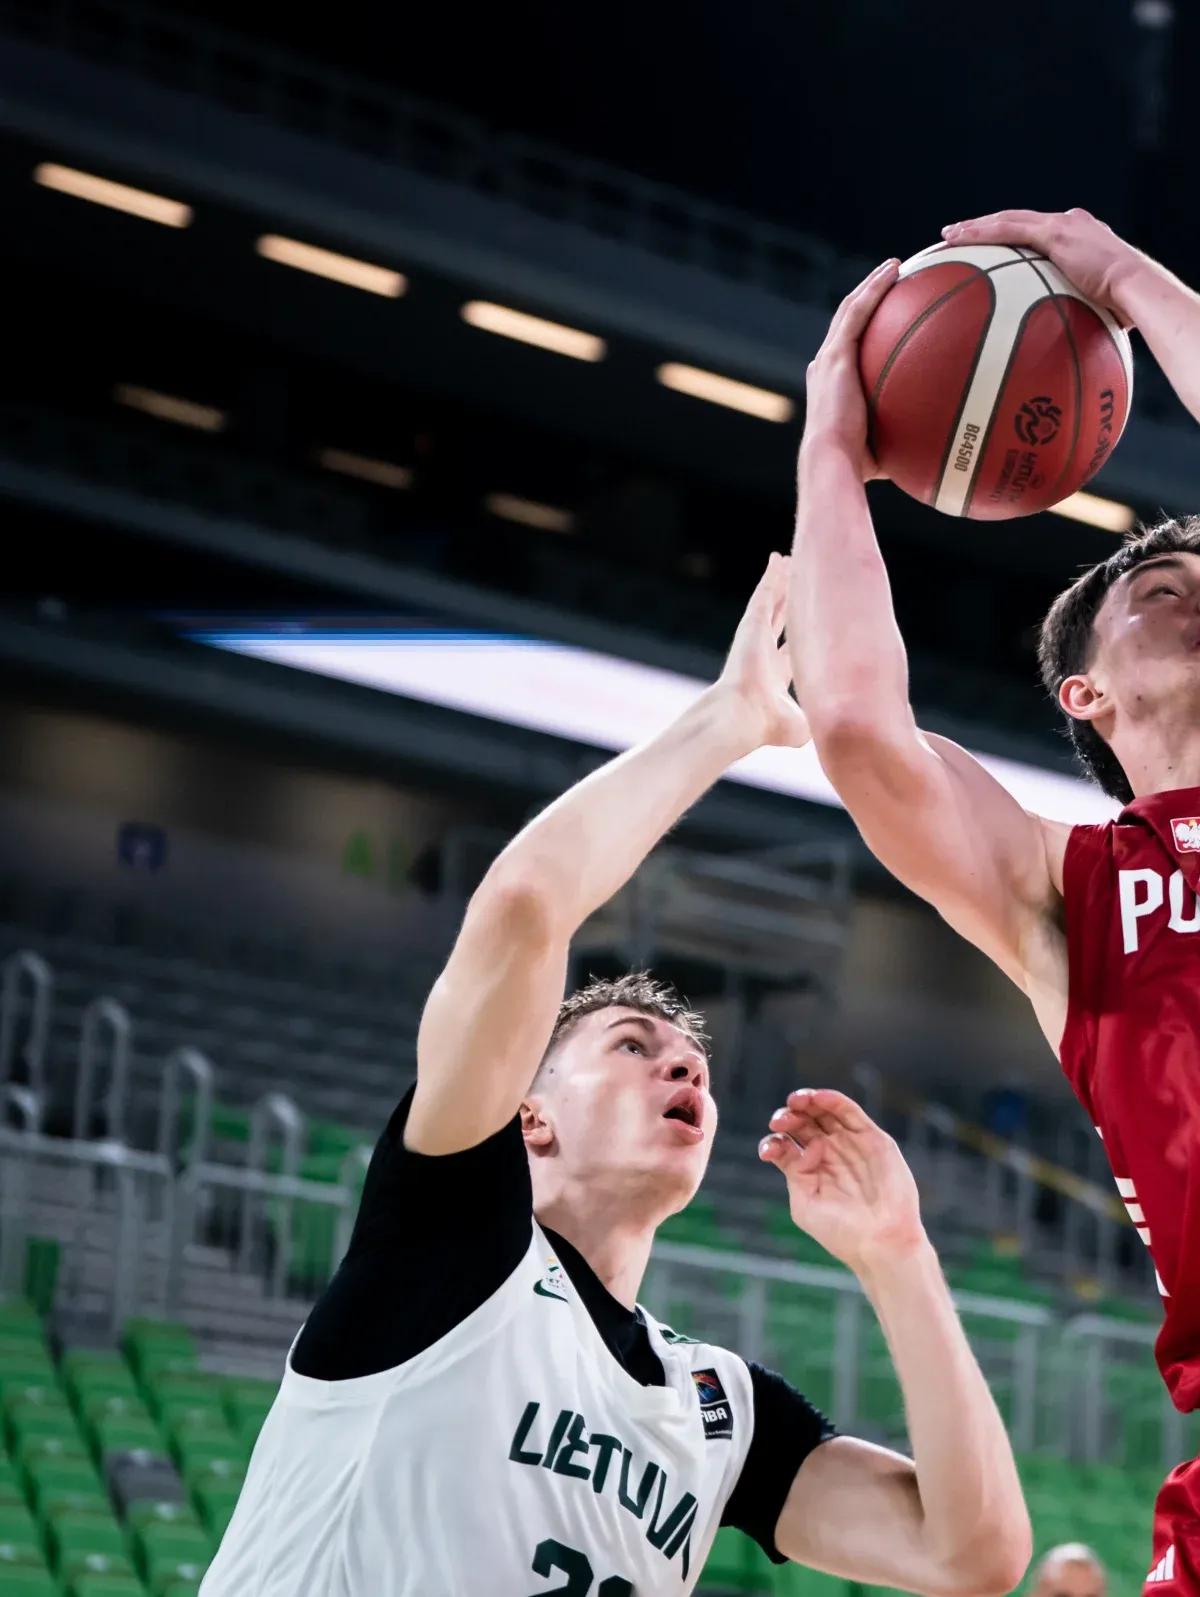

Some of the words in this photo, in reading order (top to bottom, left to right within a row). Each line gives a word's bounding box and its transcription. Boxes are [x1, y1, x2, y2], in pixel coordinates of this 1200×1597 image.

[954, 423, 980, 472] BG4500
[508, 1401, 699, 1583] LIETUVA
[528, 1537, 638, 1597] 2
